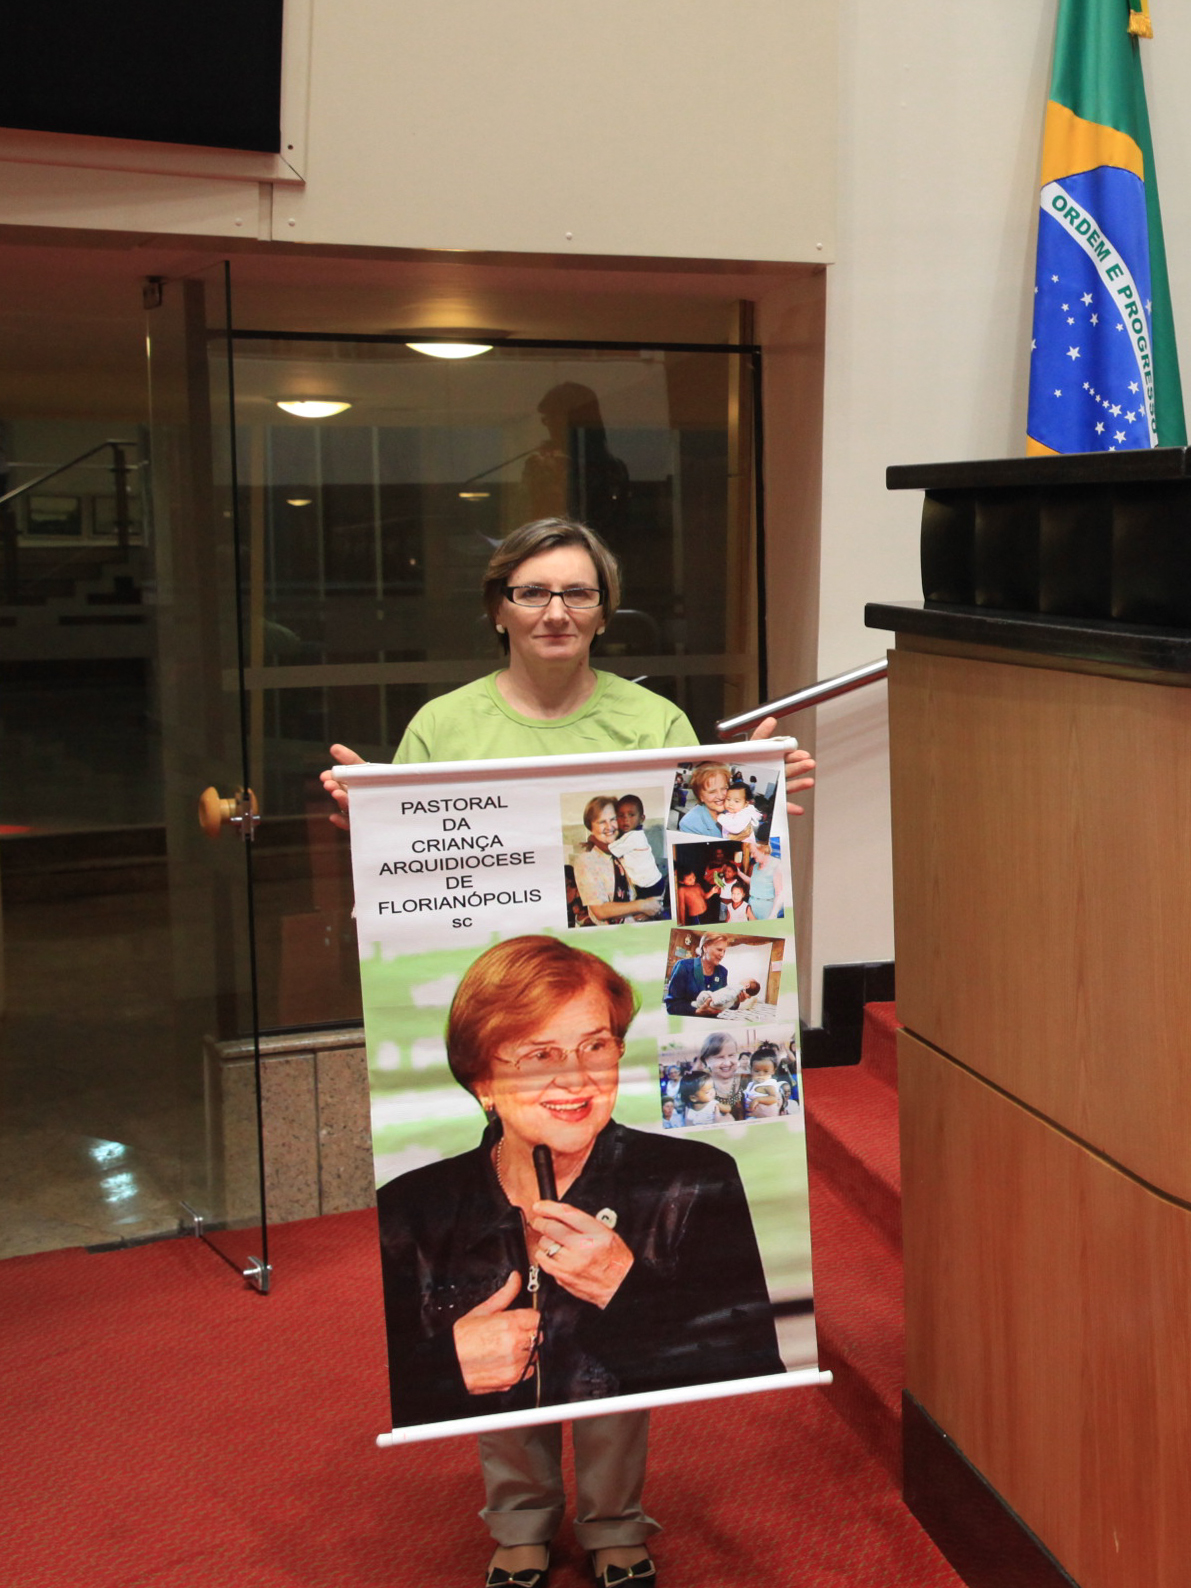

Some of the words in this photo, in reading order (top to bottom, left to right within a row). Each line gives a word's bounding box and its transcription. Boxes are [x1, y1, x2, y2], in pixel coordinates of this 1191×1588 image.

[1051, 194, 1112, 263] ORDEM
[1105, 263, 1125, 282] E
[401, 795, 509, 815] PASTORAL
[442, 817, 471, 832] DA
[411, 834, 504, 854] CRIANÇA
[379, 851, 536, 876] ARQUIDIOCESE
[445, 875, 474, 890] DE
[378, 889, 543, 915] FLORIANÓPOLIS
[452, 917, 474, 928] SC
